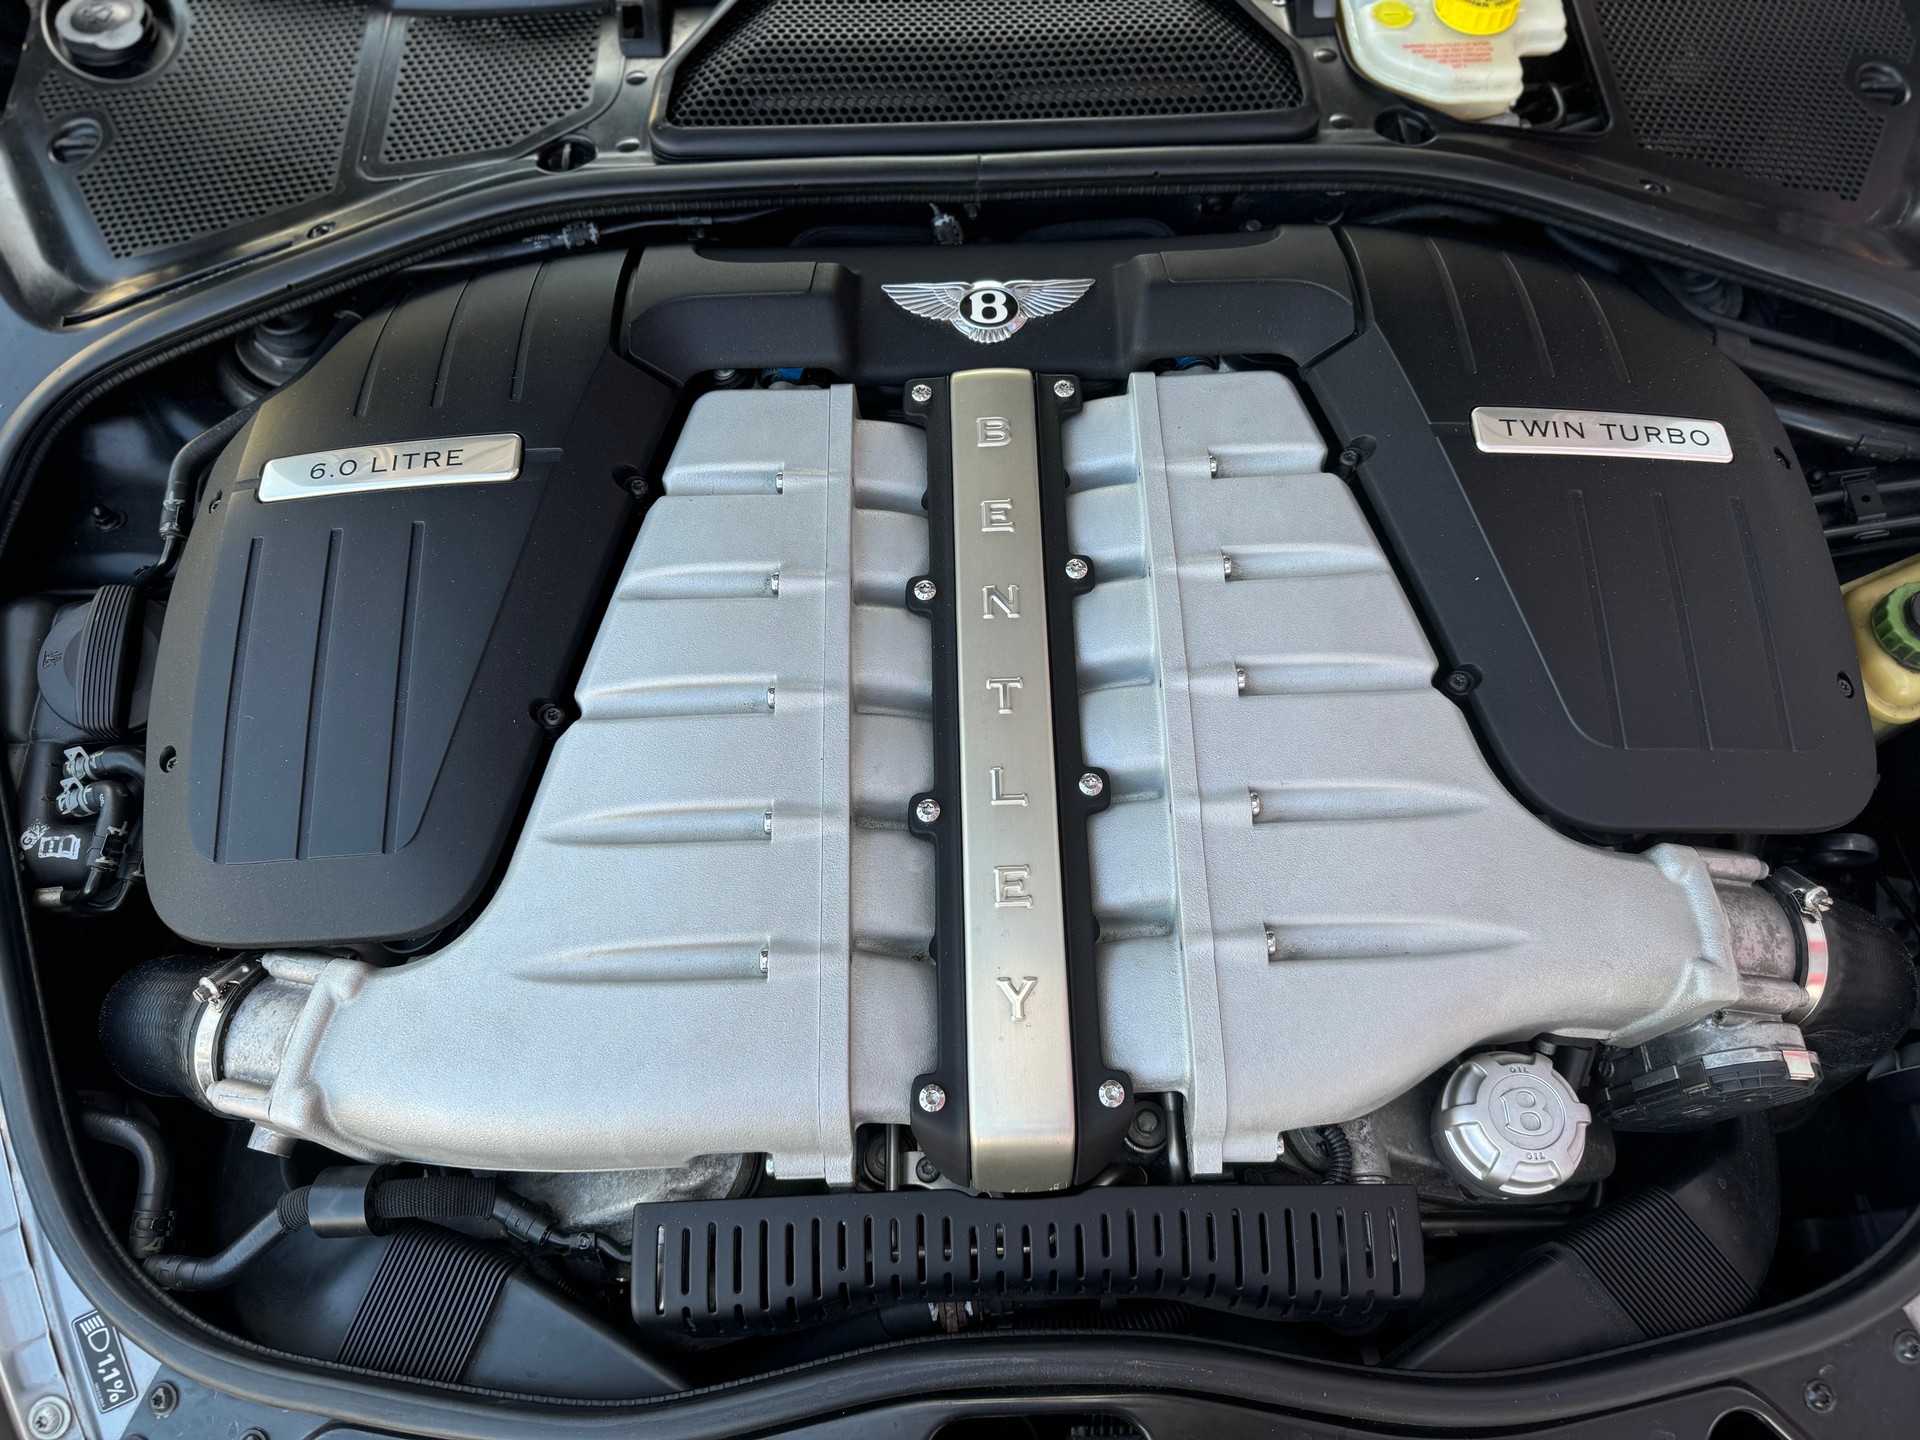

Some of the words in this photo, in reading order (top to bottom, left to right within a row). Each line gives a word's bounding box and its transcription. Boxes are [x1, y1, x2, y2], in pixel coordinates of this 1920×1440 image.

[969, 290, 1009, 324] B
[1498, 418, 1586, 439] TWIN
[1599, 422, 1710, 447] TURBO
[309, 459, 358, 480] 6.0
[371, 448, 464, 474] LITRE
[976, 416, 1038, 1022] BENTLEY
[1509, 1066, 1530, 1074] OIL
[1500, 1086, 1555, 1137] B
[1525, 1151, 1546, 1160] OIL
